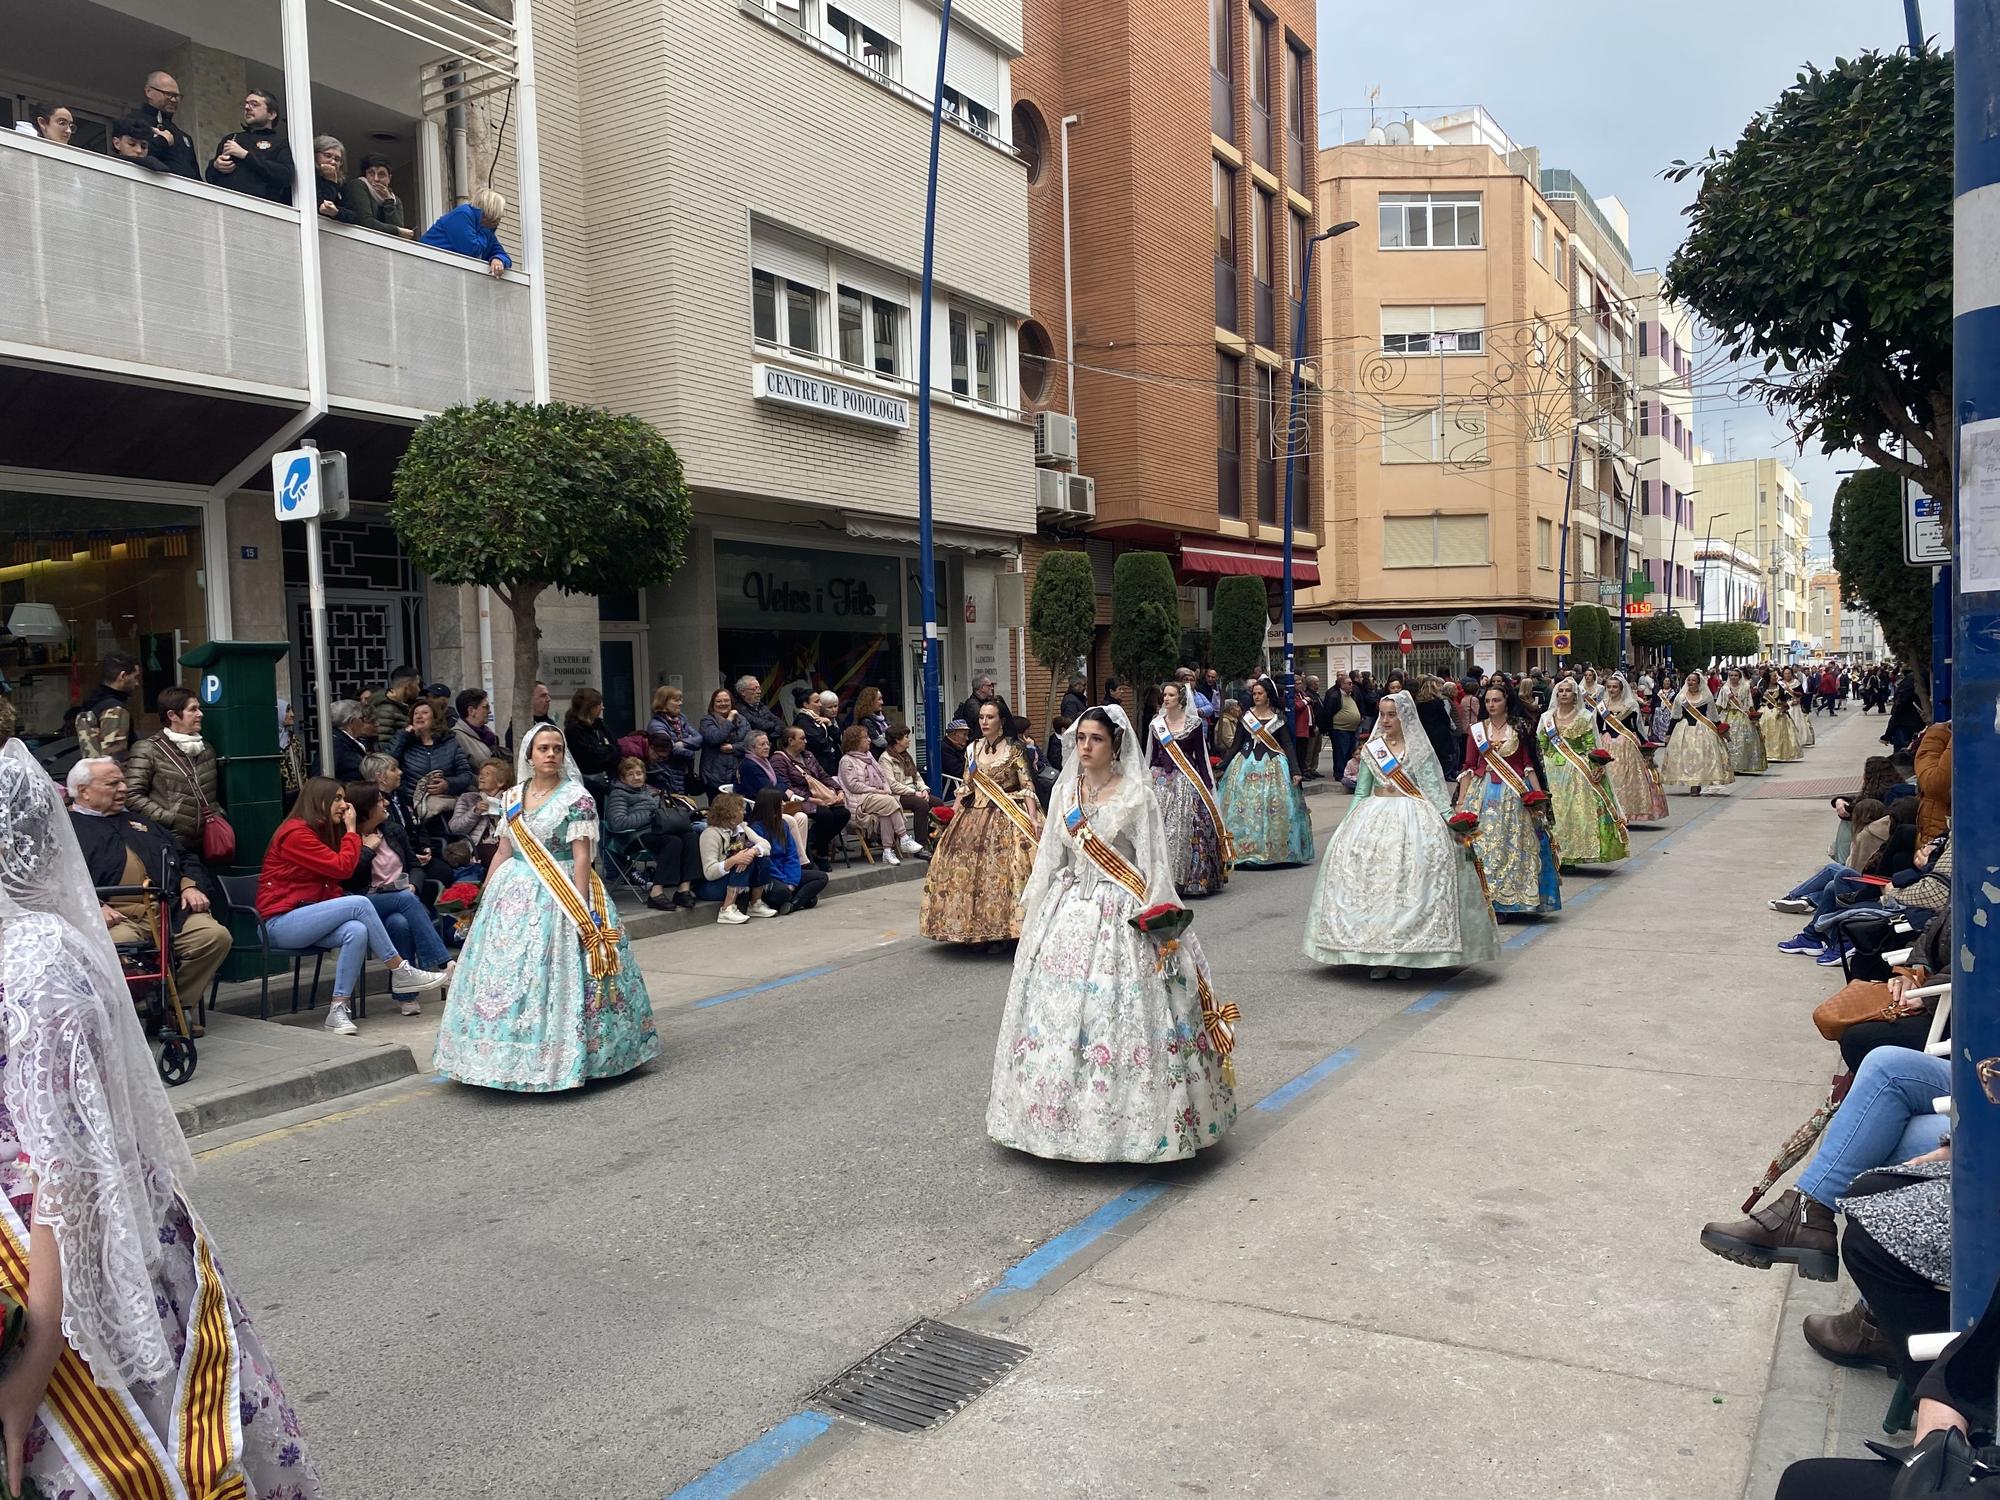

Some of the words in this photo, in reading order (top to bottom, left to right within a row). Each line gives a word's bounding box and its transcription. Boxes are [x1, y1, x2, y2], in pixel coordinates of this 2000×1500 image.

[767, 371, 818, 402] CENTRE
[822, 385, 838, 407] DE
[842, 390, 905, 423] PODOLOGIA
[246, 548, 255, 558] 15
[743, 571, 811, 614] Veles
[816, 587, 824, 614] i
[828, 577, 876, 617] Fils
[1600, 585, 1622, 595] FARMAC
[553, 656, 580, 664] CENTRE
[582, 656, 591, 664] DE
[554, 667, 591, 675] PODOLOGIA
[206, 675, 220, 702] P
